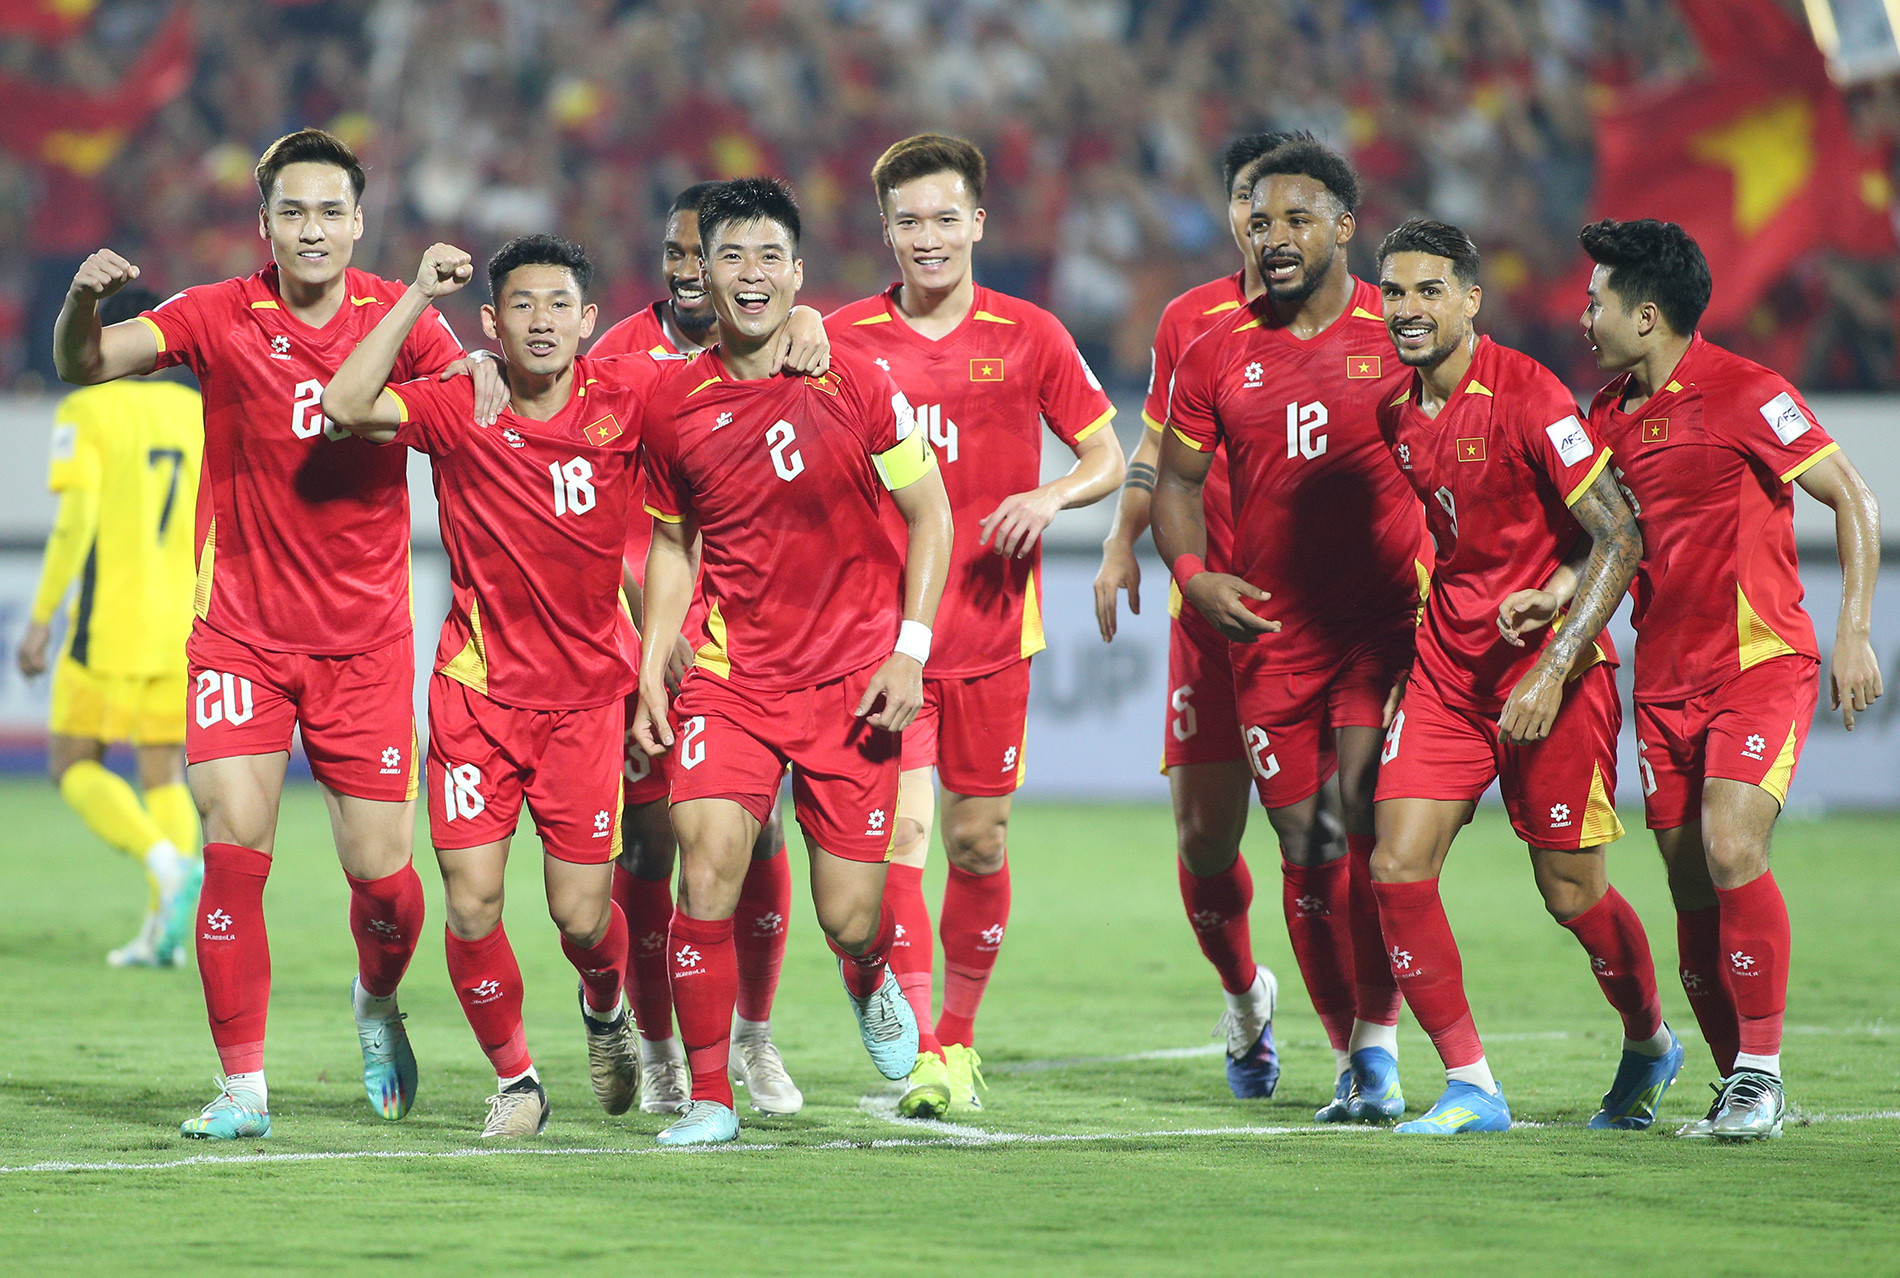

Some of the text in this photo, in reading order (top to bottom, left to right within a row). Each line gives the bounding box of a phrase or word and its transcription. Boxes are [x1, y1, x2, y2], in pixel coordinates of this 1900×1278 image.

[1286, 400, 1329, 461] 12
[1561, 430, 1584, 450] AFC
[1777, 406, 1797, 428] AFC
[766, 418, 805, 482] 2
[149, 449, 183, 546] 7
[548, 456, 597, 517] 18
[1434, 485, 1458, 539] 9
[195, 669, 254, 730] 20
[680, 715, 706, 771] 2
[1381, 709, 1406, 766] 9
[443, 762, 486, 823] 18
